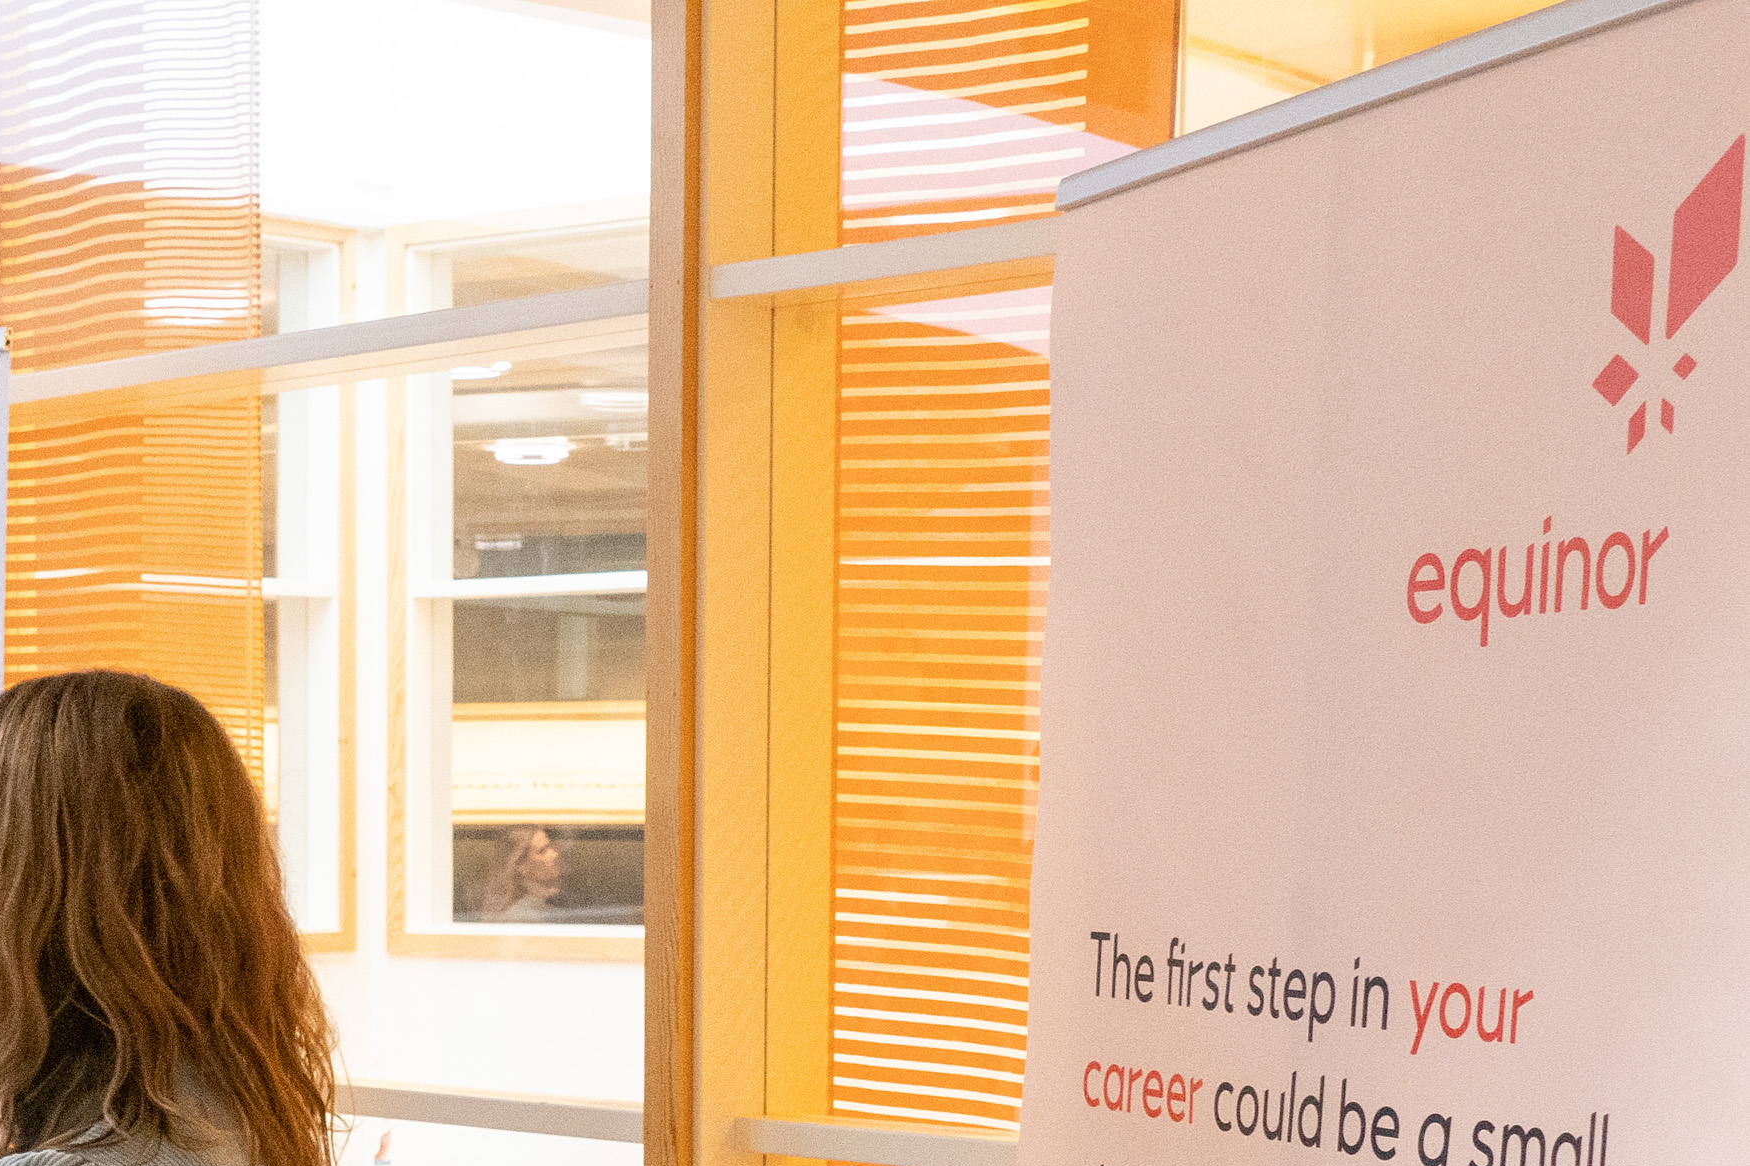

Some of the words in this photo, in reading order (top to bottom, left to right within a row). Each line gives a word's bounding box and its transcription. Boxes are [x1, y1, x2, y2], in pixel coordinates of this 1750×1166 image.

[1406, 515, 1670, 648] equinor
[1089, 930, 1155, 1003] The
[1166, 936, 1237, 1014] first
[1246, 956, 1337, 1043] step
[1349, 956, 1391, 1031] in
[1409, 978, 1535, 1056] your
[1082, 1060, 1204, 1125] career
[1213, 1070, 1327, 1149] could
[1336, 1077, 1401, 1162] be
